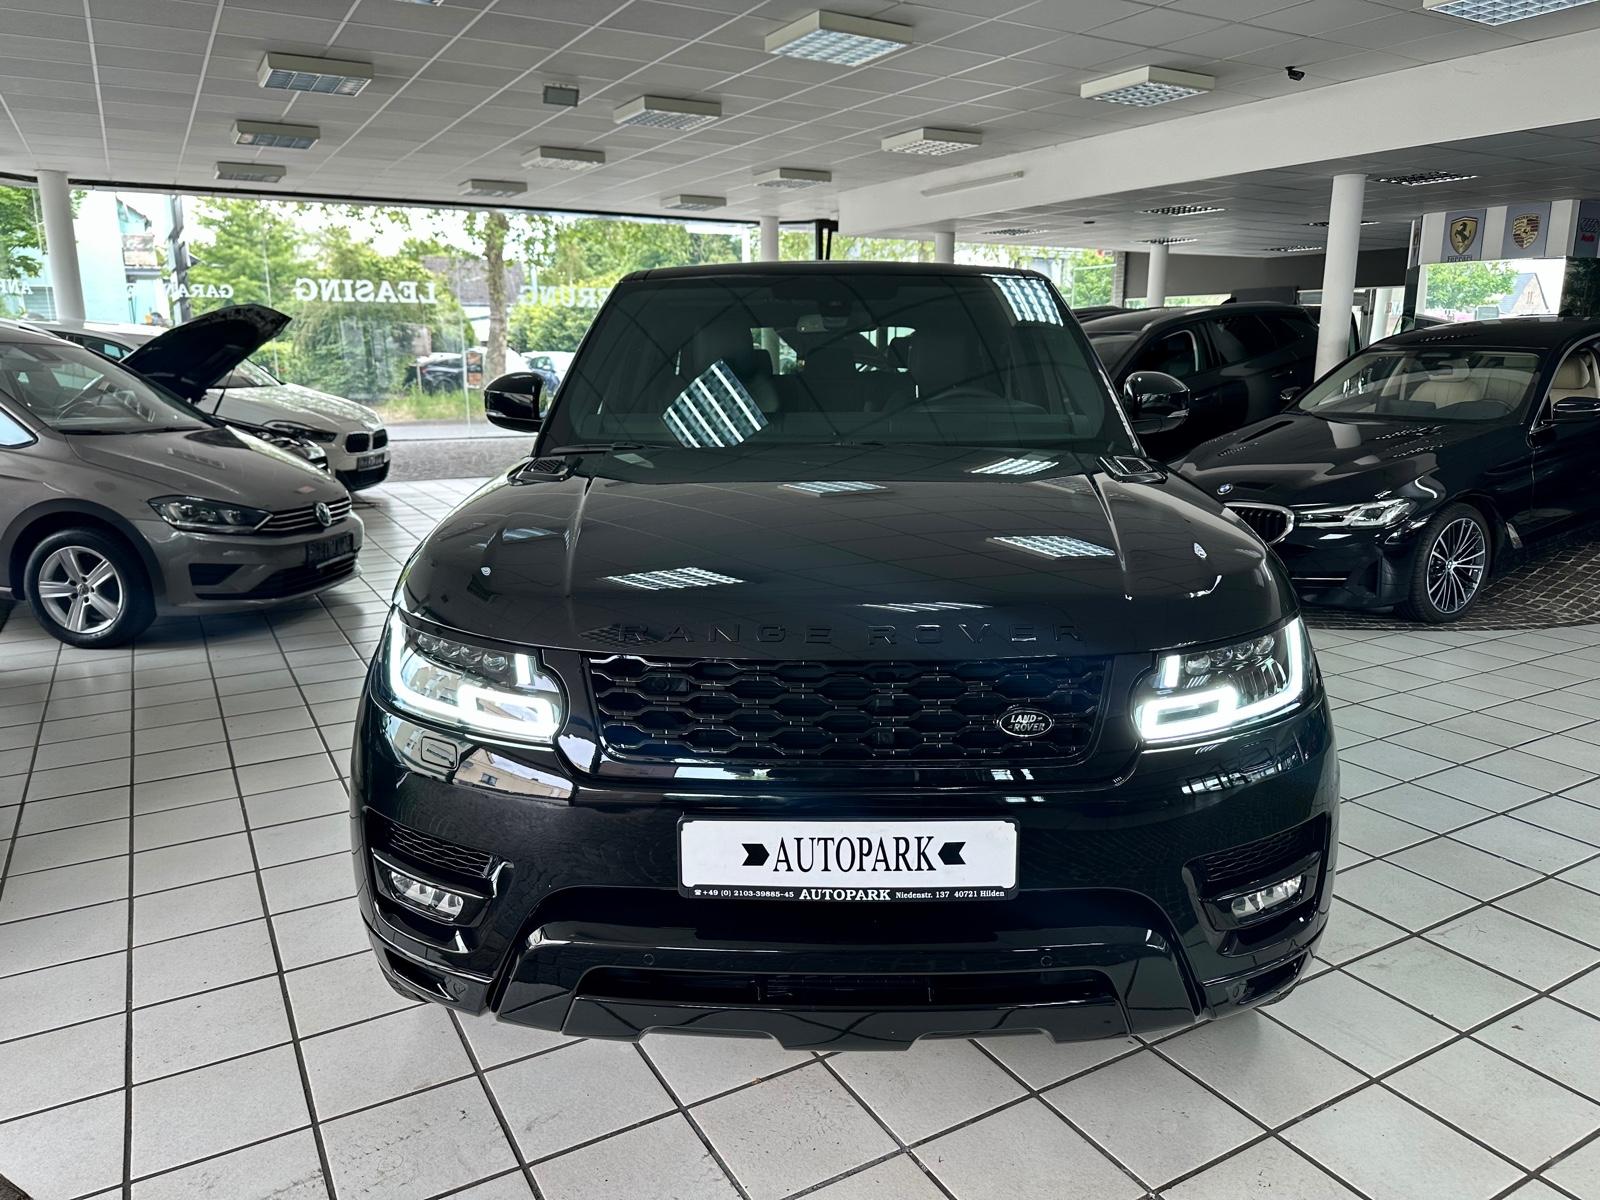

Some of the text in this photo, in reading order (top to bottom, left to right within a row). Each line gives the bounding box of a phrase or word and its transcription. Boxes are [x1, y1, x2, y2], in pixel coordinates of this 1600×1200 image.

[616, 623, 1084, 645] RANGE ROVER
[773, 836, 937, 872] AUTOPARK
[720, 889, 732, 897] (0)
[799, 888, 891, 900] AUTOPARK
[895, 891, 933, 899] Niedenstr.
[935, 890, 950, 898] 137
[954, 890, 977, 898] 40721
[980, 889, 1005, 897] Hilden
